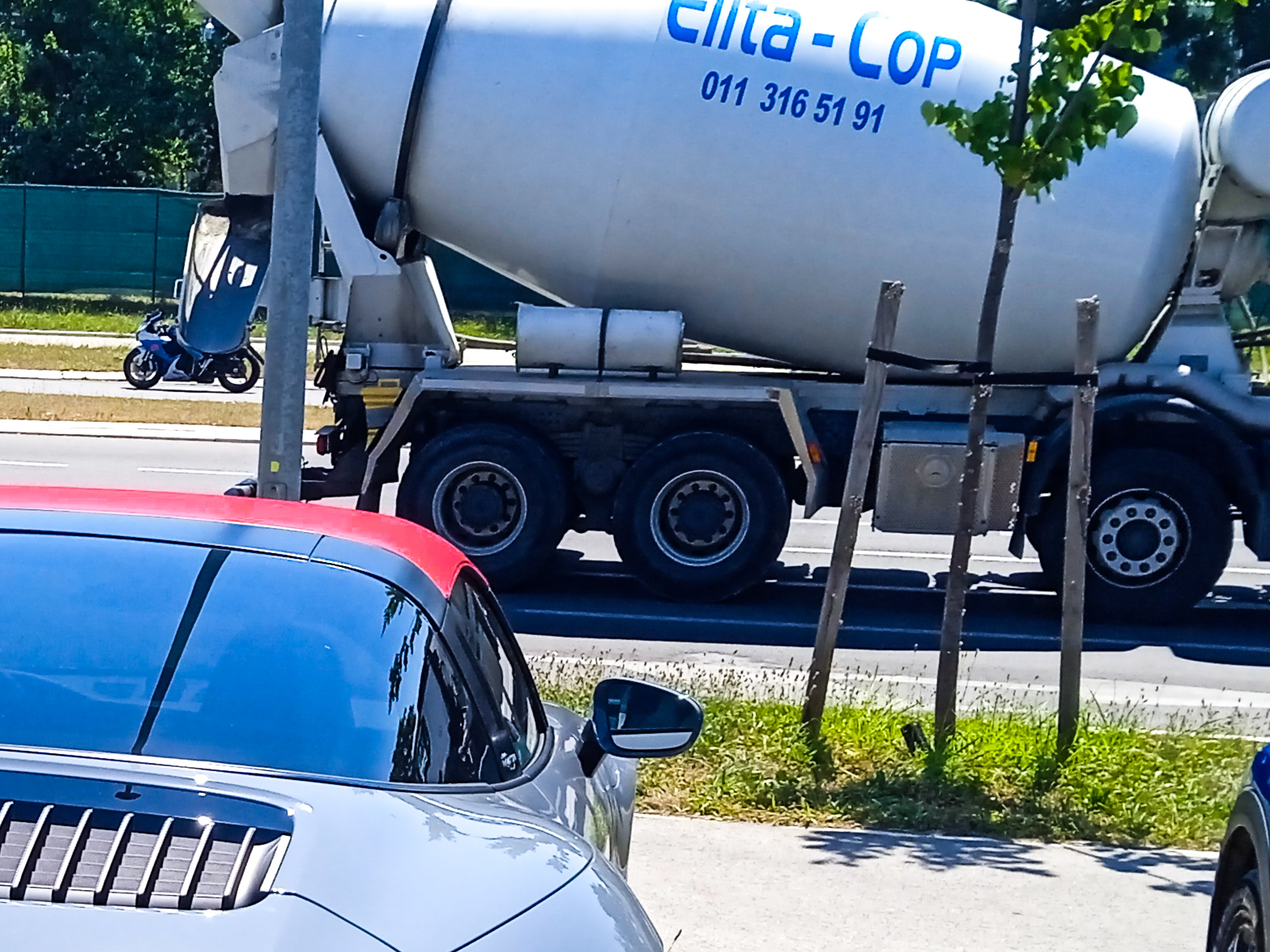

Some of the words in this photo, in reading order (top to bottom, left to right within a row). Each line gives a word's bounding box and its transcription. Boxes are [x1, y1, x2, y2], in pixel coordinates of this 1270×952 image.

[701, 71, 748, 106] 011
[760, 83, 809, 118] 316
[813, 93, 846, 126] 51
[852, 100, 885, 133] 91
